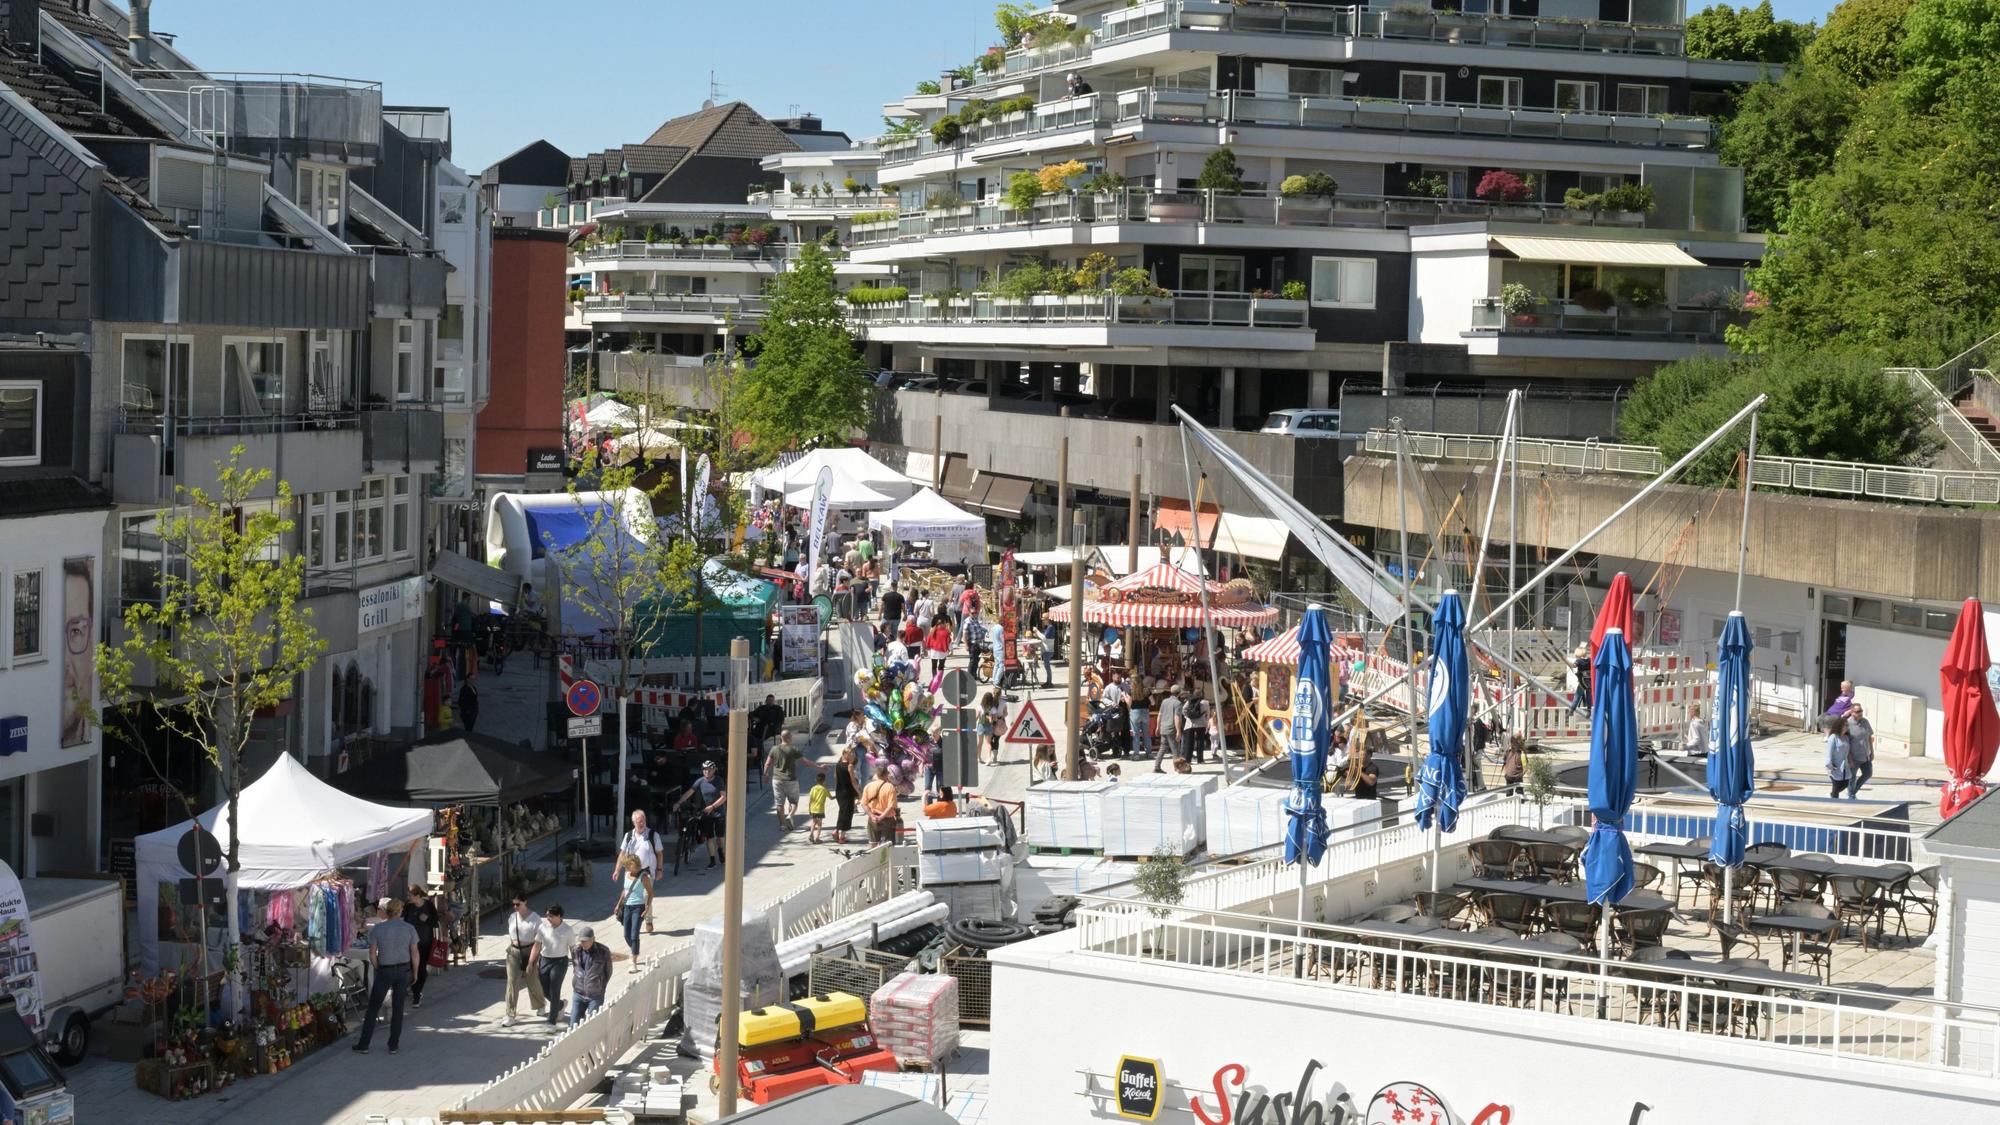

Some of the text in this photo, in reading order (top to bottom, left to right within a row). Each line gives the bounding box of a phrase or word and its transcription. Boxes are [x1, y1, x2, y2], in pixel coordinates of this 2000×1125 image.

[814, 494, 828, 549] BELKAW
[1388, 563, 1417, 579] POLZEI
[359, 585, 400, 608] essaloniki
[363, 608, 388, 628] Grill
[9, 726, 28, 739] ZEISS
[772, 1056, 790, 1065] ADLER
[1190, 1058, 1351, 1125] Sushi
